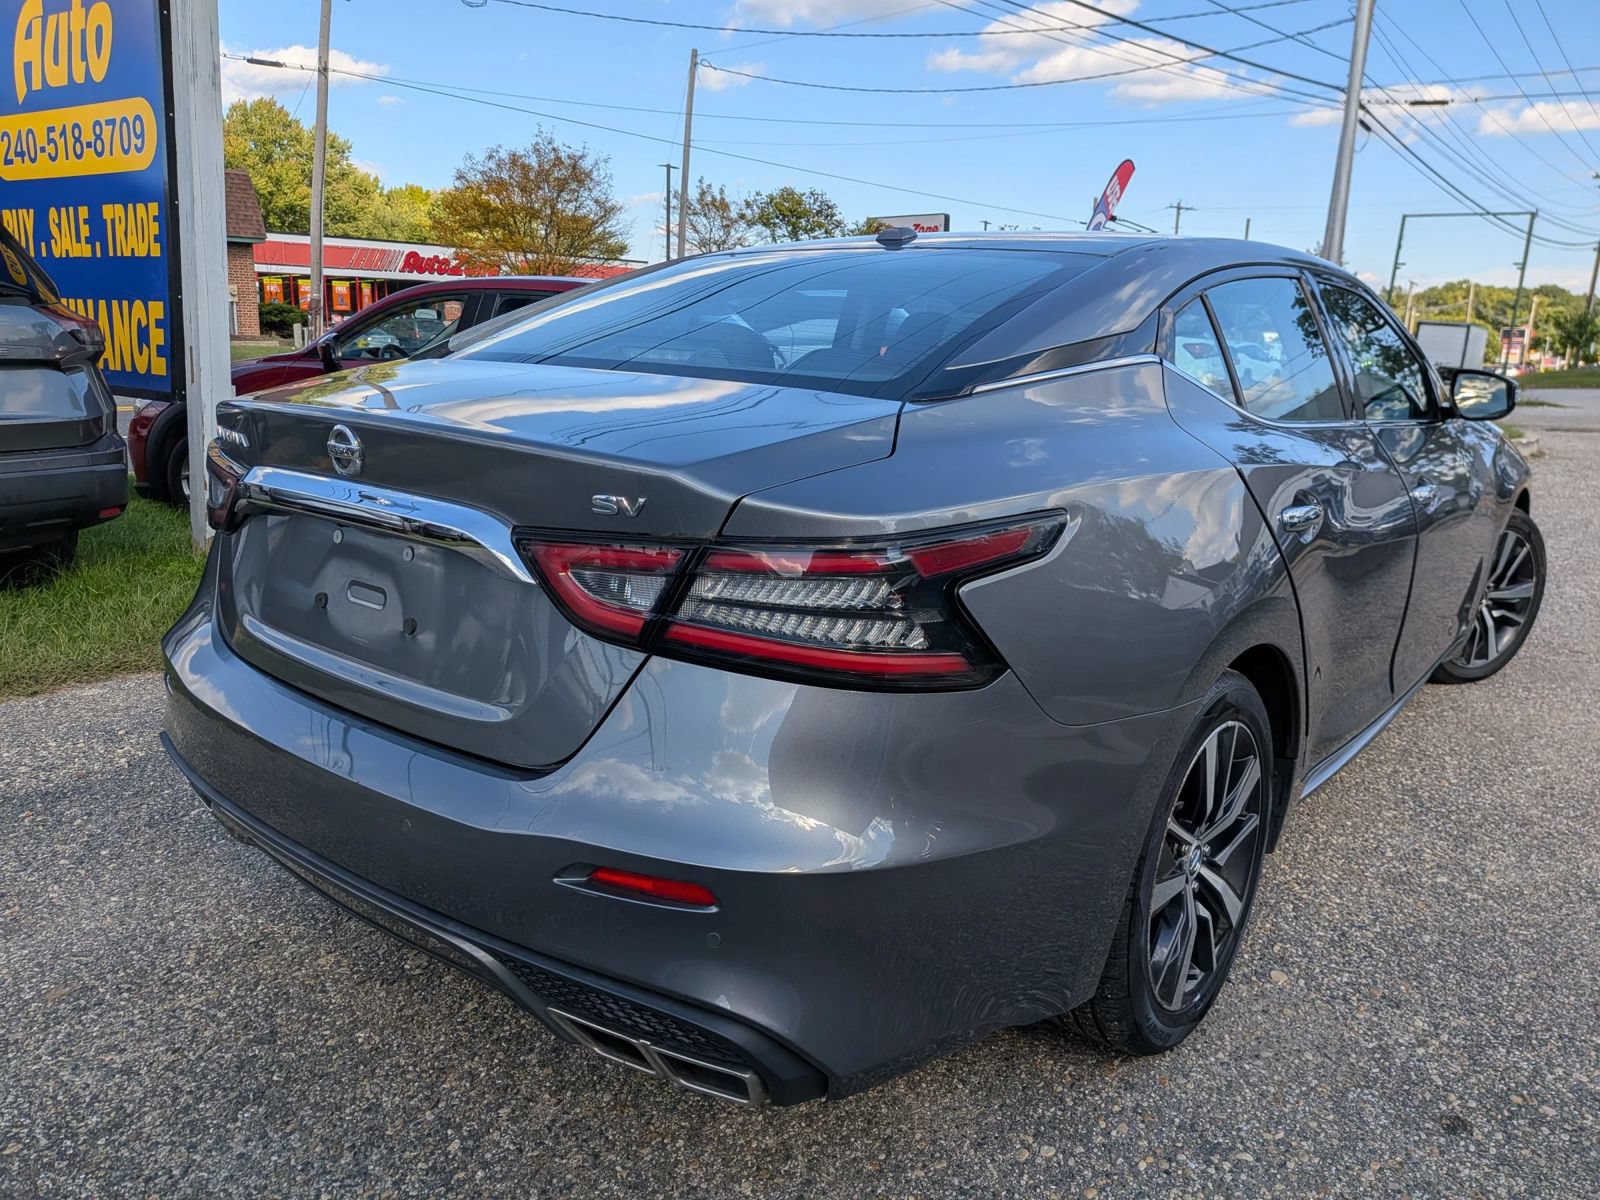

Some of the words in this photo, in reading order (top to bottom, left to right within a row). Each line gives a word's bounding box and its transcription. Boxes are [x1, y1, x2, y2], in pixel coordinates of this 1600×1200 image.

[13, 0, 113, 105] Auto
[1, 113, 146, 167] 240-518-8709
[49, 205, 91, 259] SALE
[103, 202, 161, 258] TRADE
[60, 298, 167, 376] ANCE
[592, 495, 648, 518] SV
